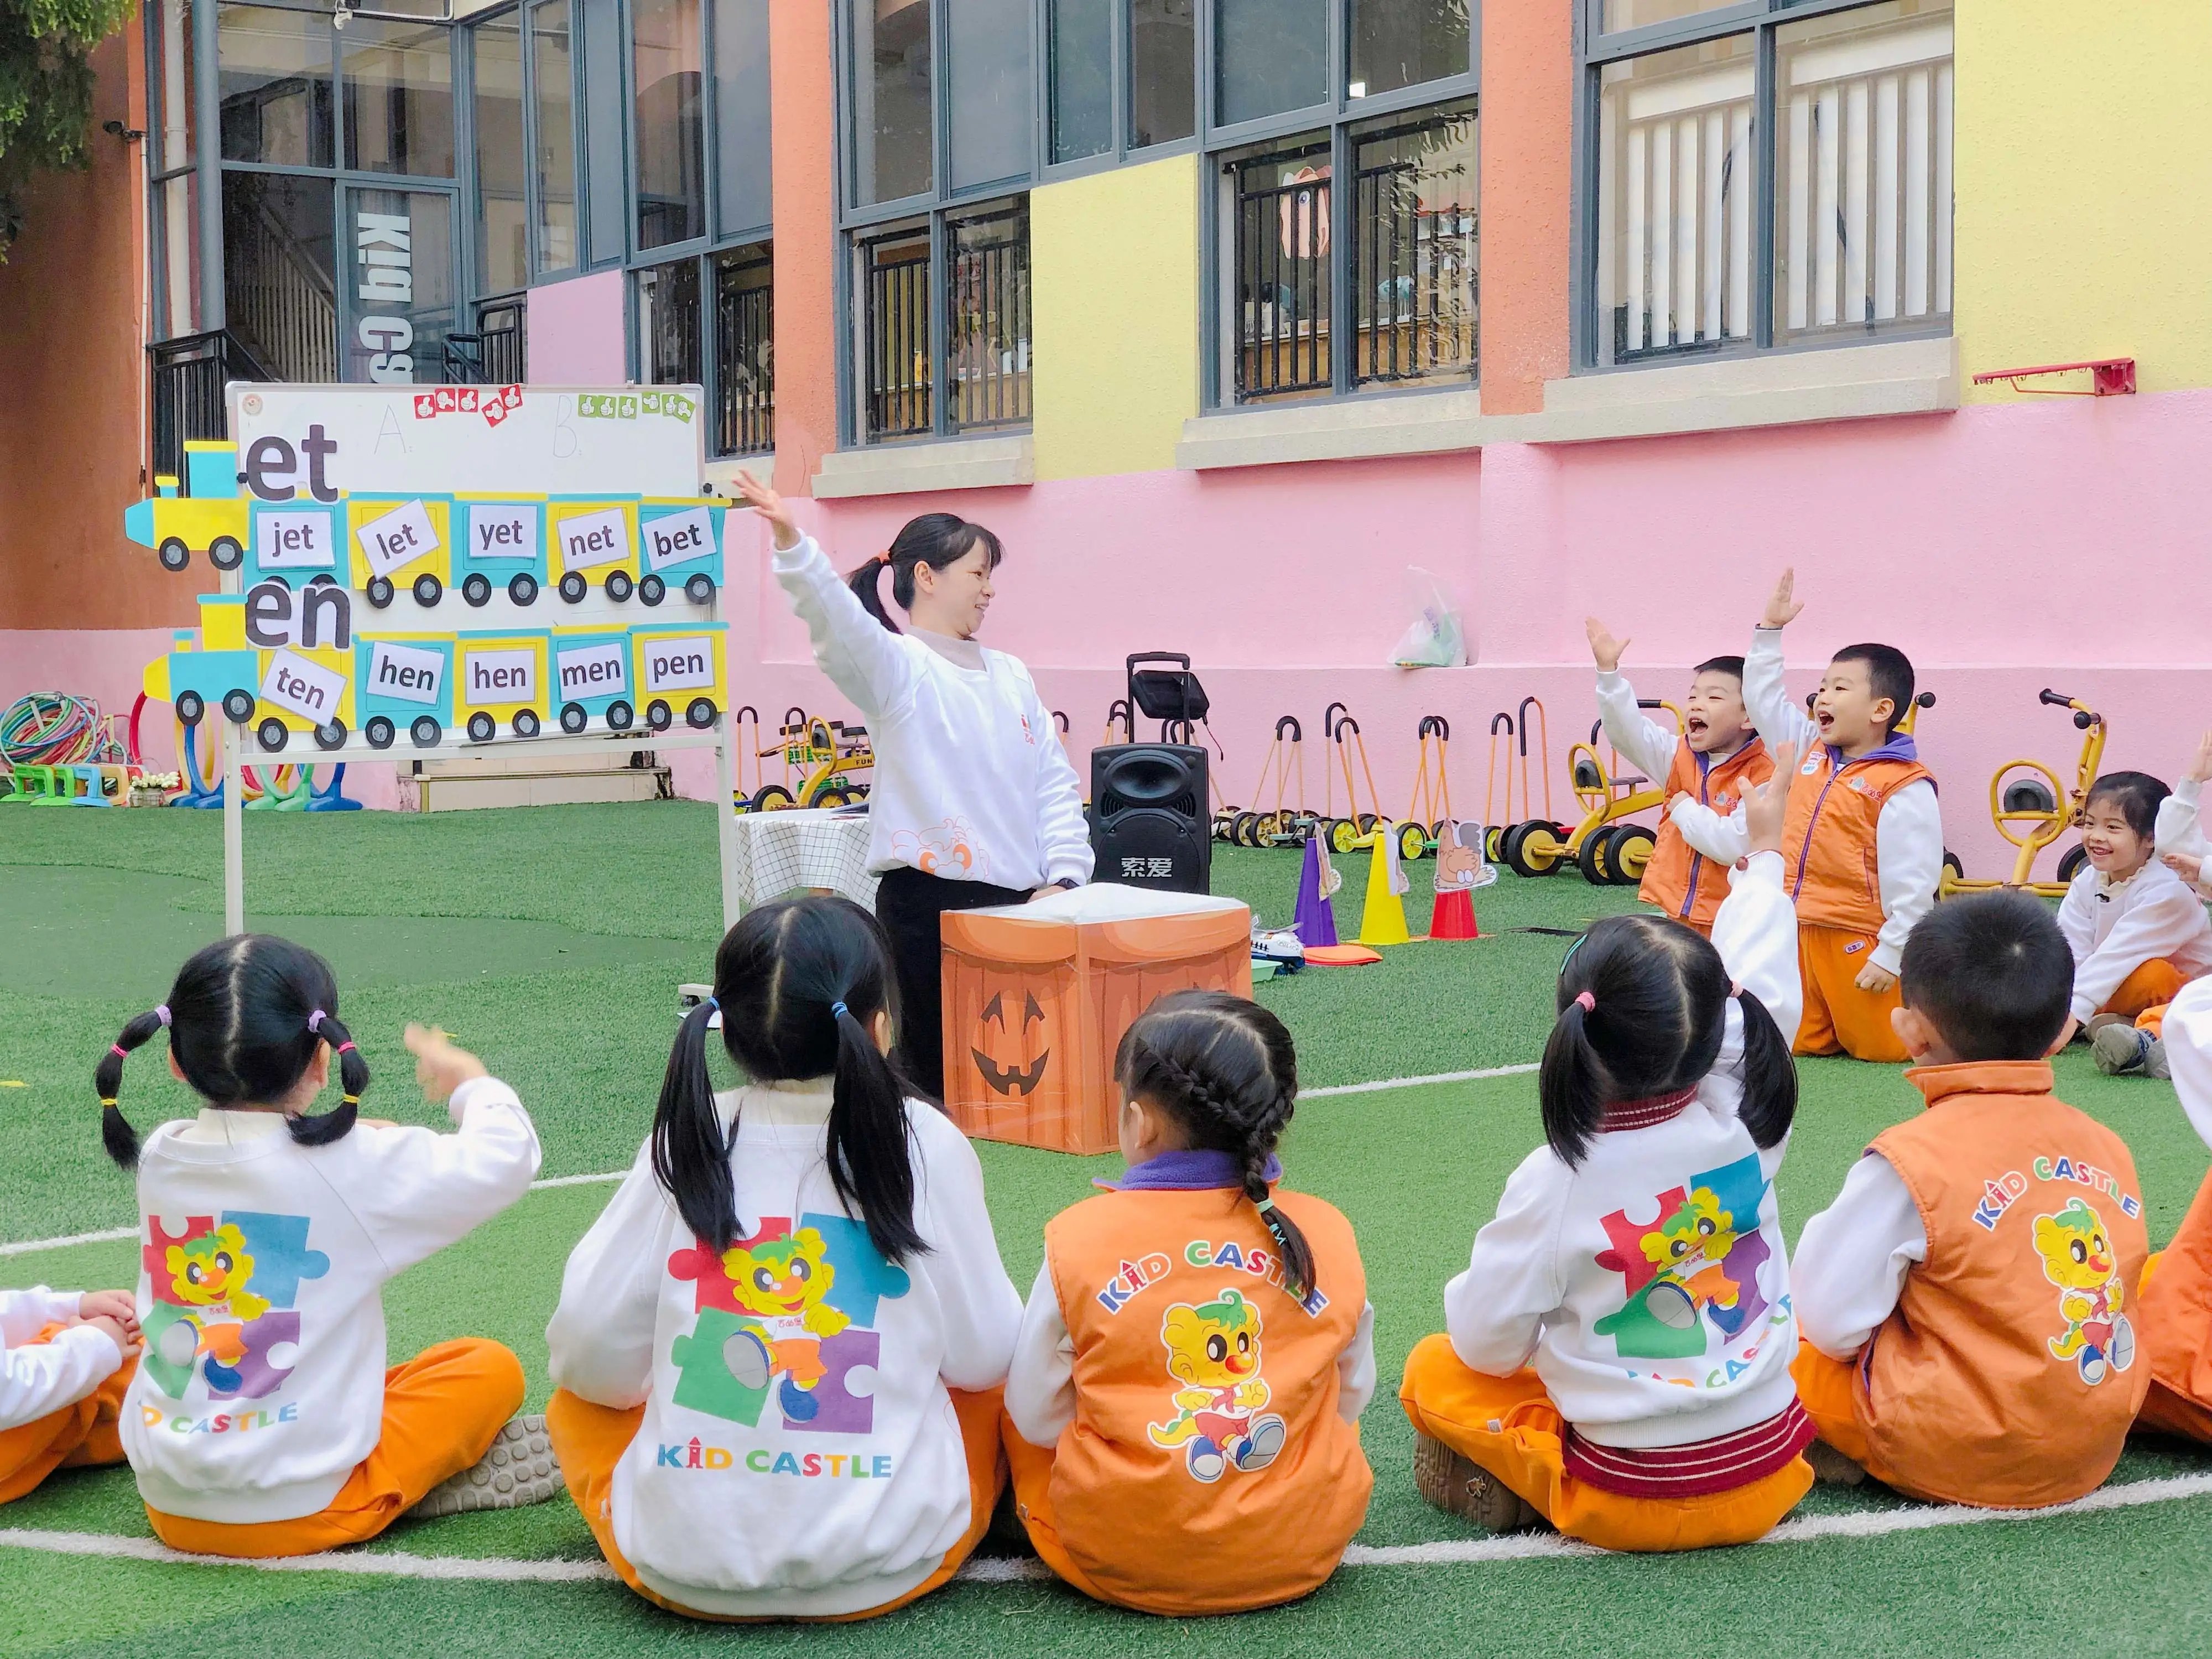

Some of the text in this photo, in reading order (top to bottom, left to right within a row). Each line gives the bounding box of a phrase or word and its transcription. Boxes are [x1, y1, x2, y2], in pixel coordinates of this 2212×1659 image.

[247, 425, 339, 502] et
[272, 520, 702, 560] jet let yet net bet
[246, 584, 350, 649] en
[277, 653, 704, 709] ten hen hen men pen
[1121, 857, 1173, 878] 索爱
[2034, 1156, 2140, 1219] CASTLE
[169, 1402, 298, 1434] CASTLE
[746, 1449, 892, 1478] CASTLE
